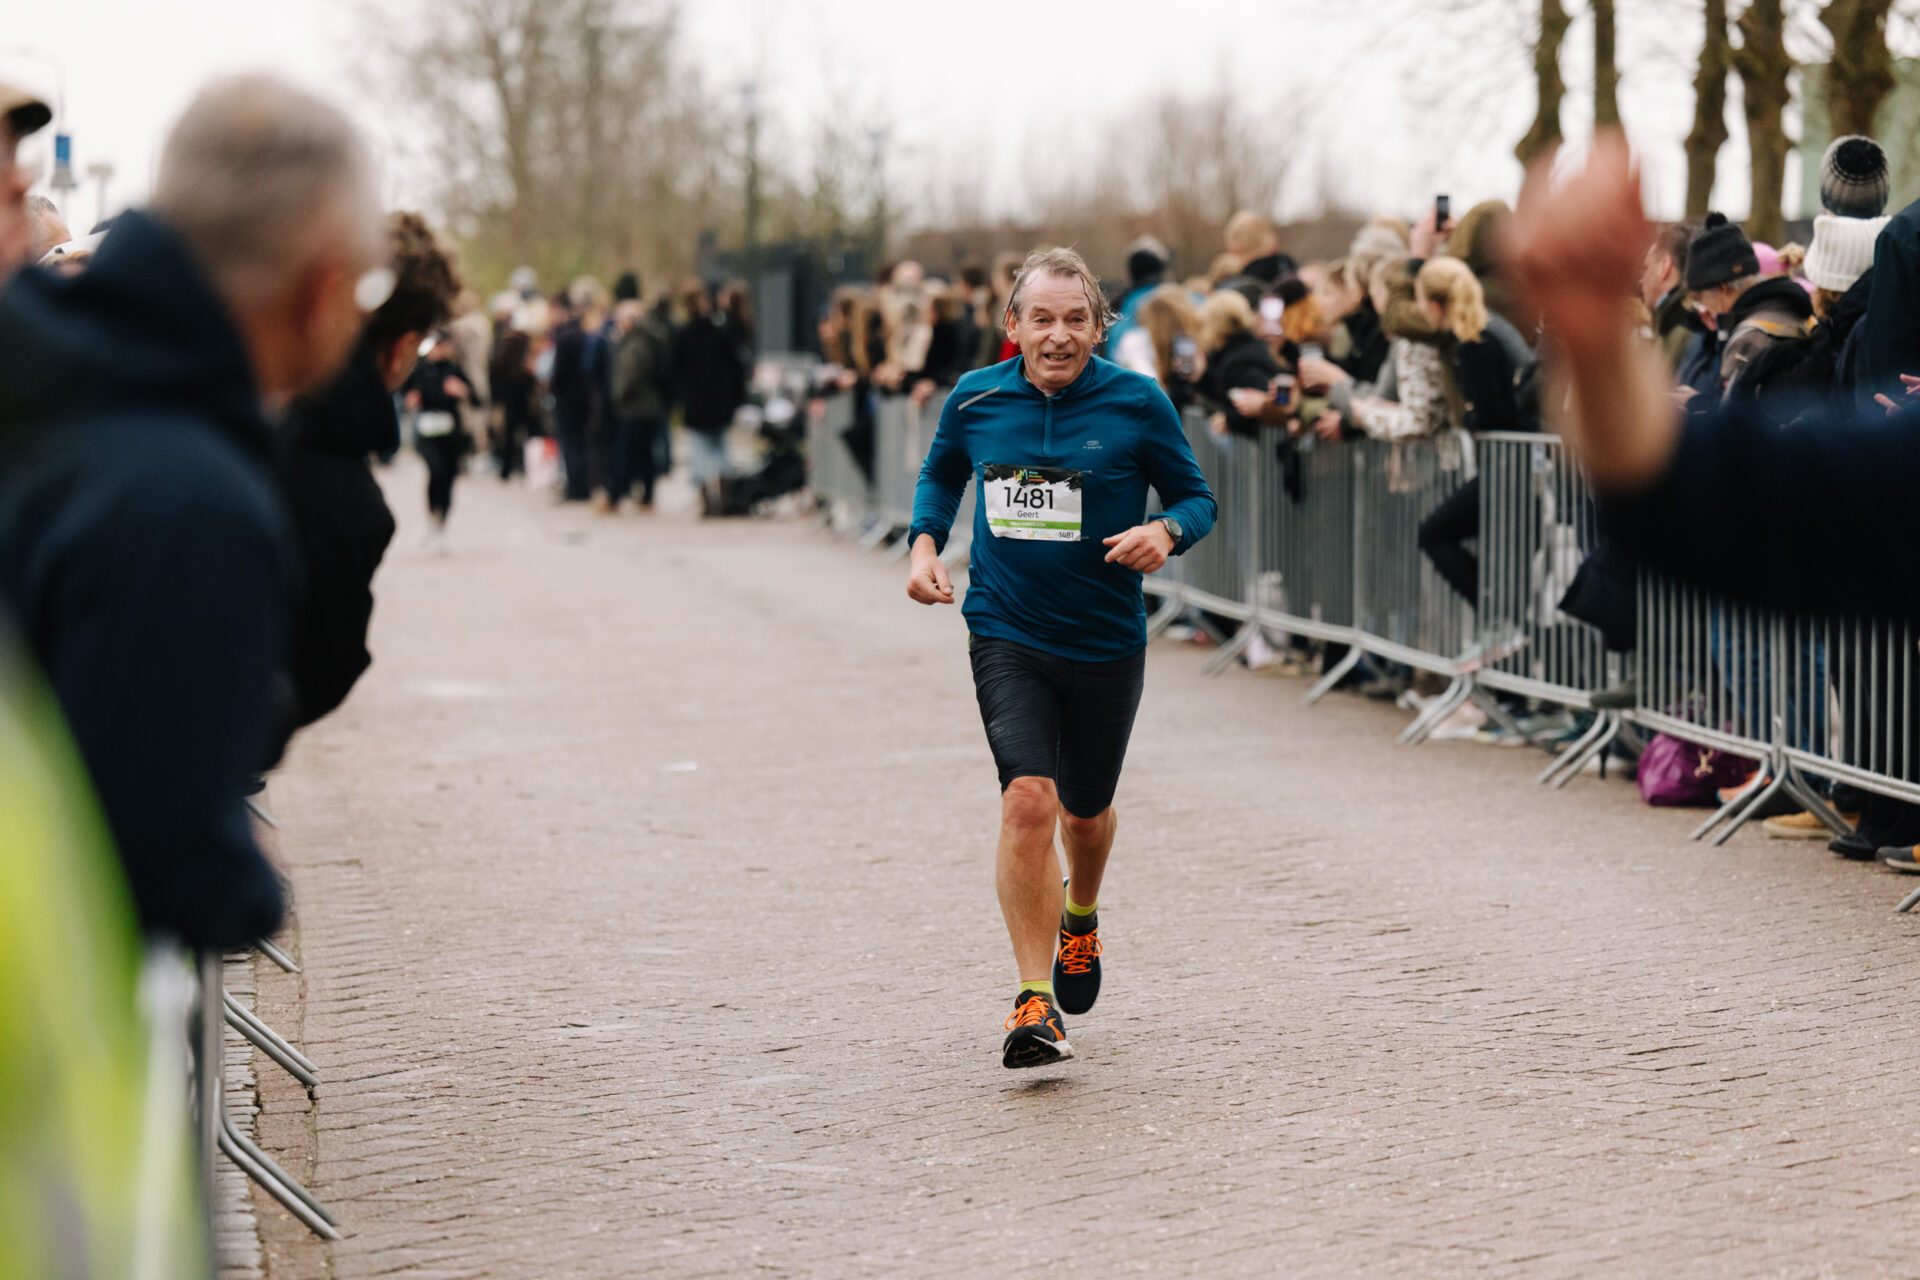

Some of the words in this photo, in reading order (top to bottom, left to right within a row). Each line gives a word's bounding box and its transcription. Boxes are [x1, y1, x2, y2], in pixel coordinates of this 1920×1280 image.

[1004, 487, 1054, 509] 1481
[1017, 510, 1040, 519] Geert
[1059, 531, 1074, 539] 1481
